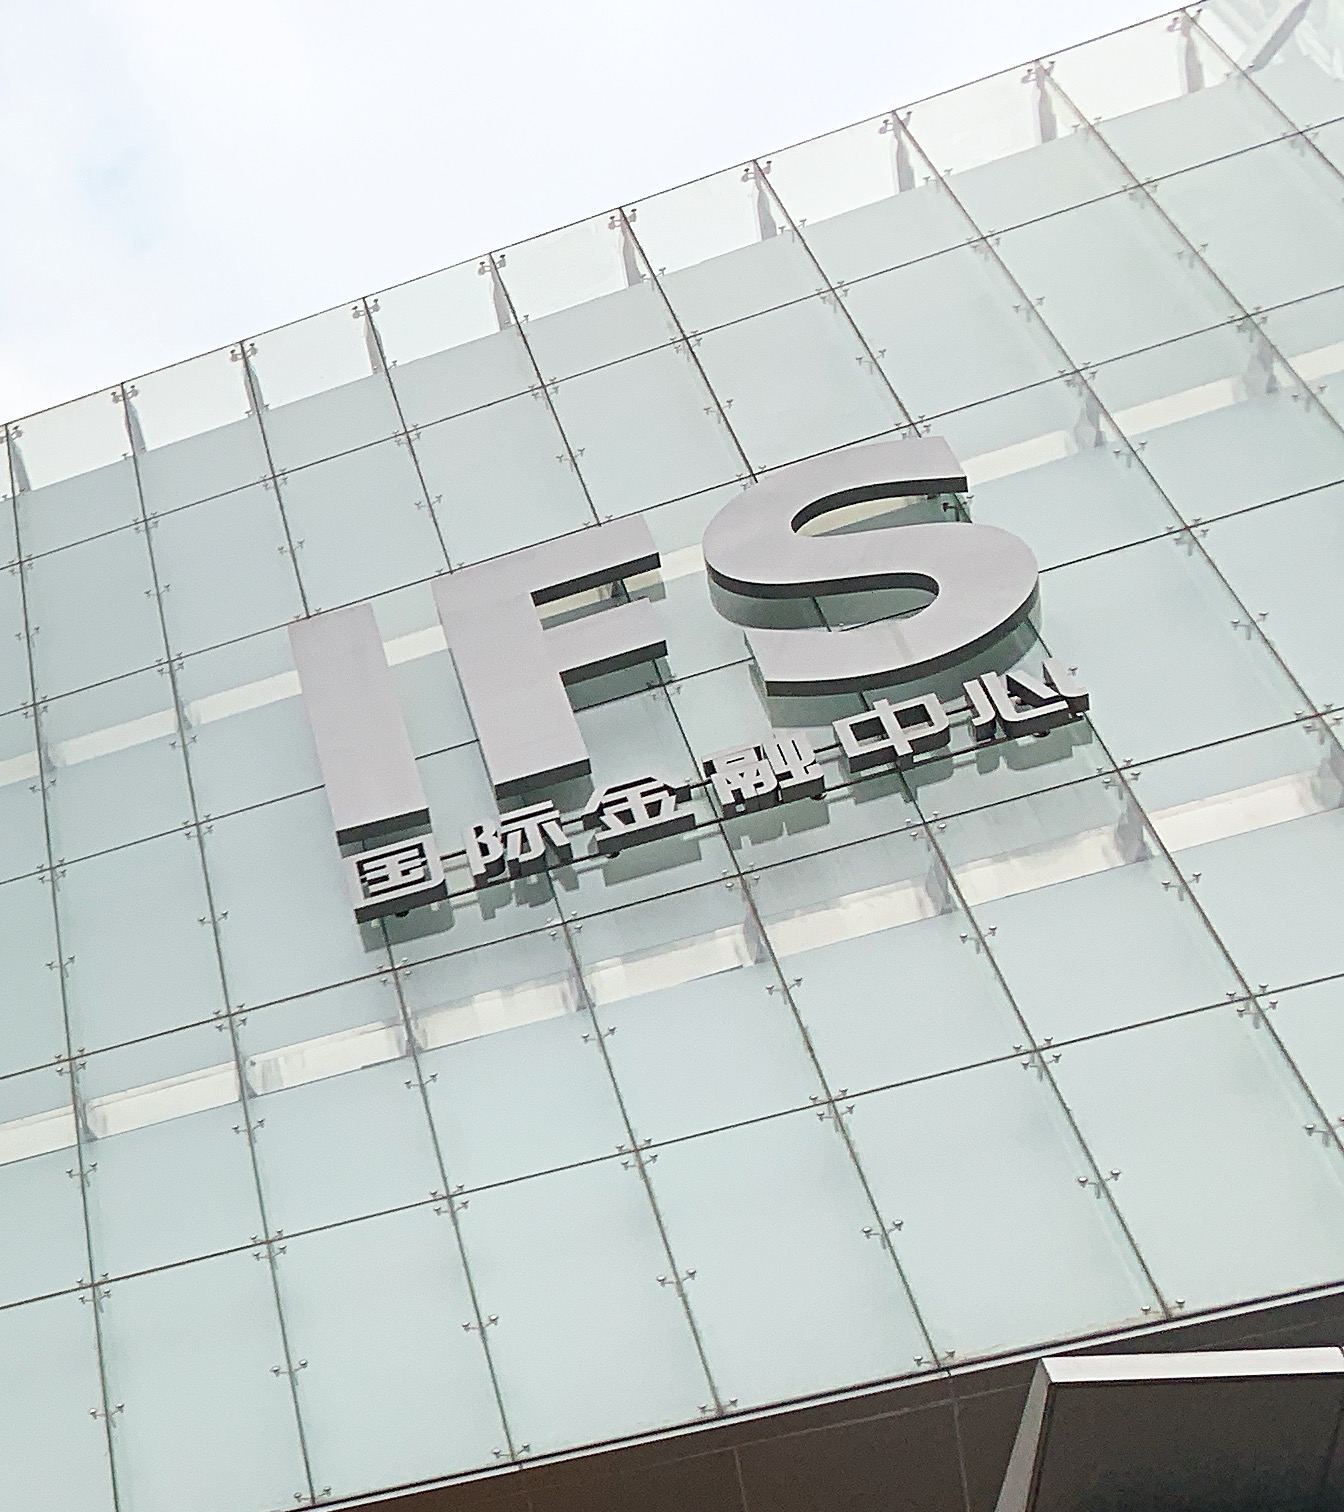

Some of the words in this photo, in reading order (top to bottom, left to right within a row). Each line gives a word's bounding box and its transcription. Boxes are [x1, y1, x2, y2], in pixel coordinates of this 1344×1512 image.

[288, 436, 1040, 842] IFS
[342, 660, 1089, 920] 国际金融中心
